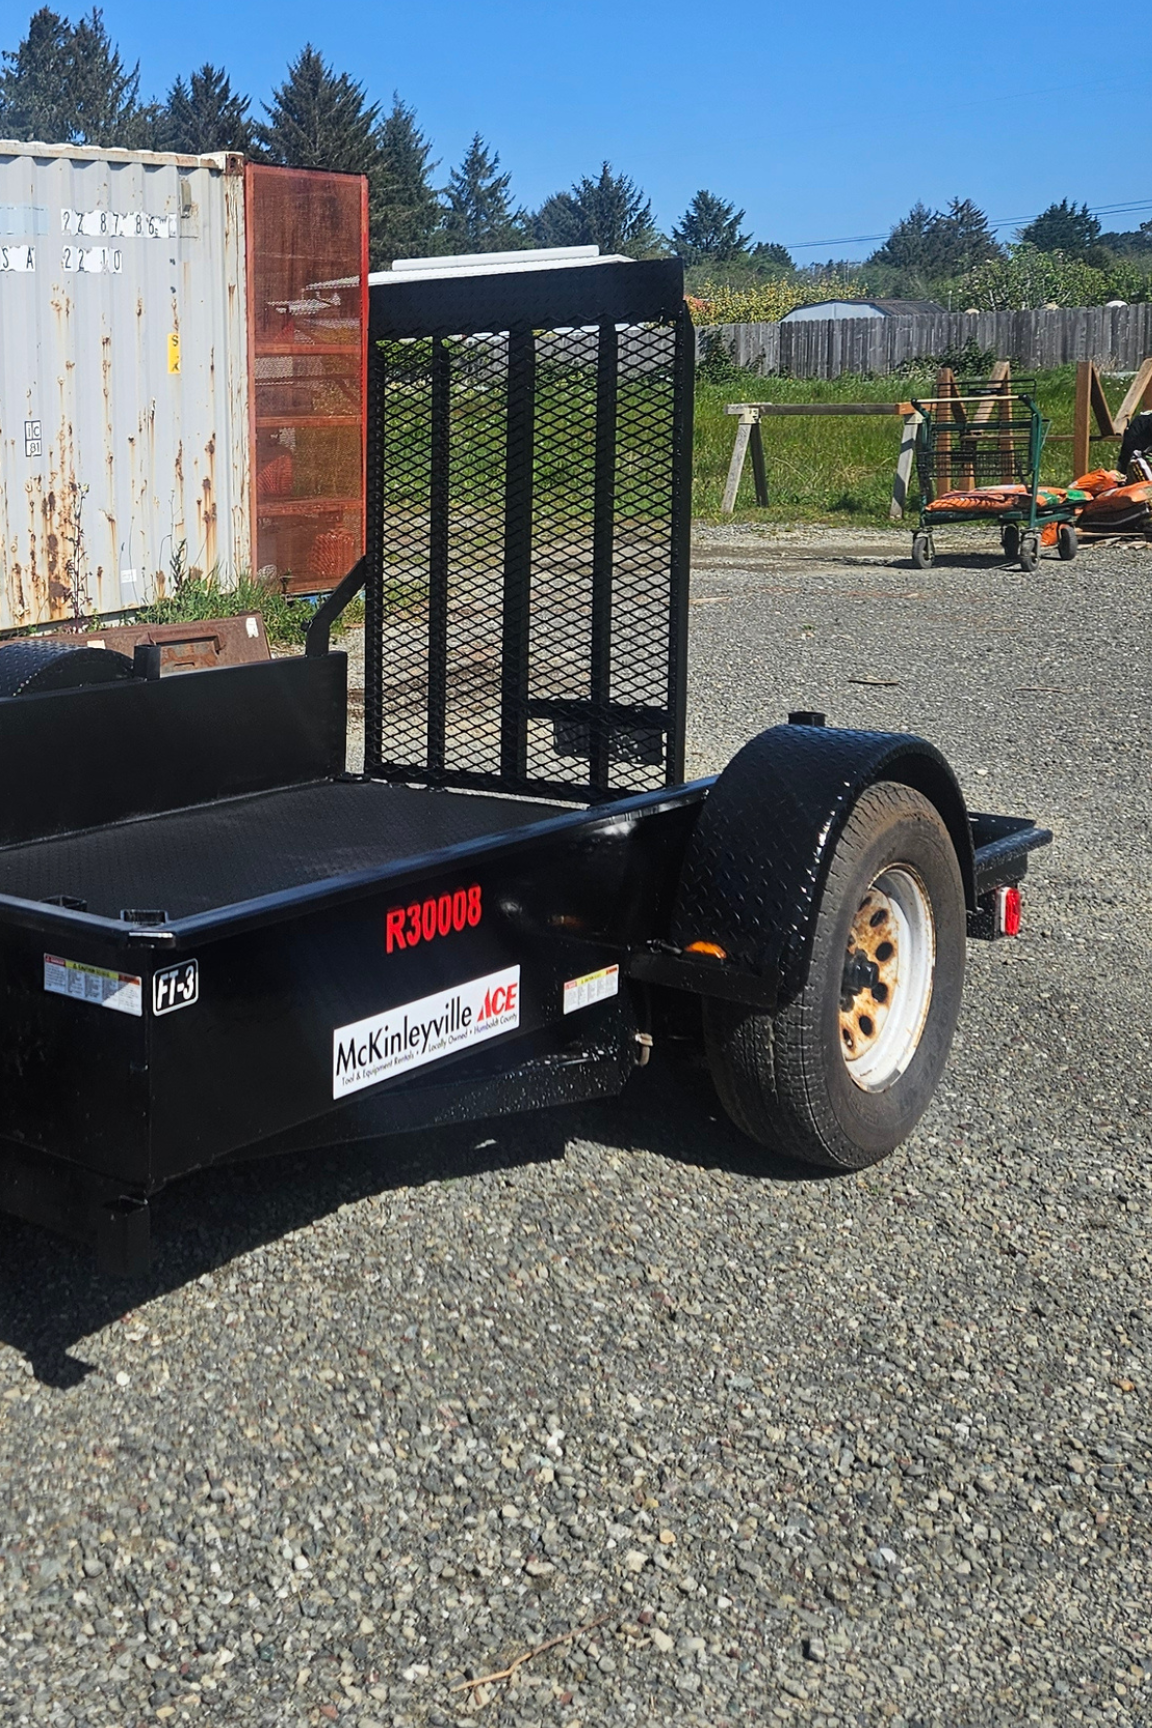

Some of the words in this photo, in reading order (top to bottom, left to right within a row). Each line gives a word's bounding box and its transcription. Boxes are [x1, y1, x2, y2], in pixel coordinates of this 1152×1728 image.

[386, 884, 483, 955] R30008
[157, 965, 194, 1010] FT-3
[336, 996, 472, 1076] McKinleyville
[477, 983, 518, 1022] ACE
[342, 1075, 354, 1086] Tool
[356, 1071, 361, 1080] &
[362, 1060, 393, 1079] Equipment
[394, 1052, 414, 1067] Rentals
[428, 1037, 447, 1053] Locally
[448, 1029, 469, 1045] Owned
[473, 1019, 499, 1036] Humboldt
[500, 1013, 518, 1026] County
